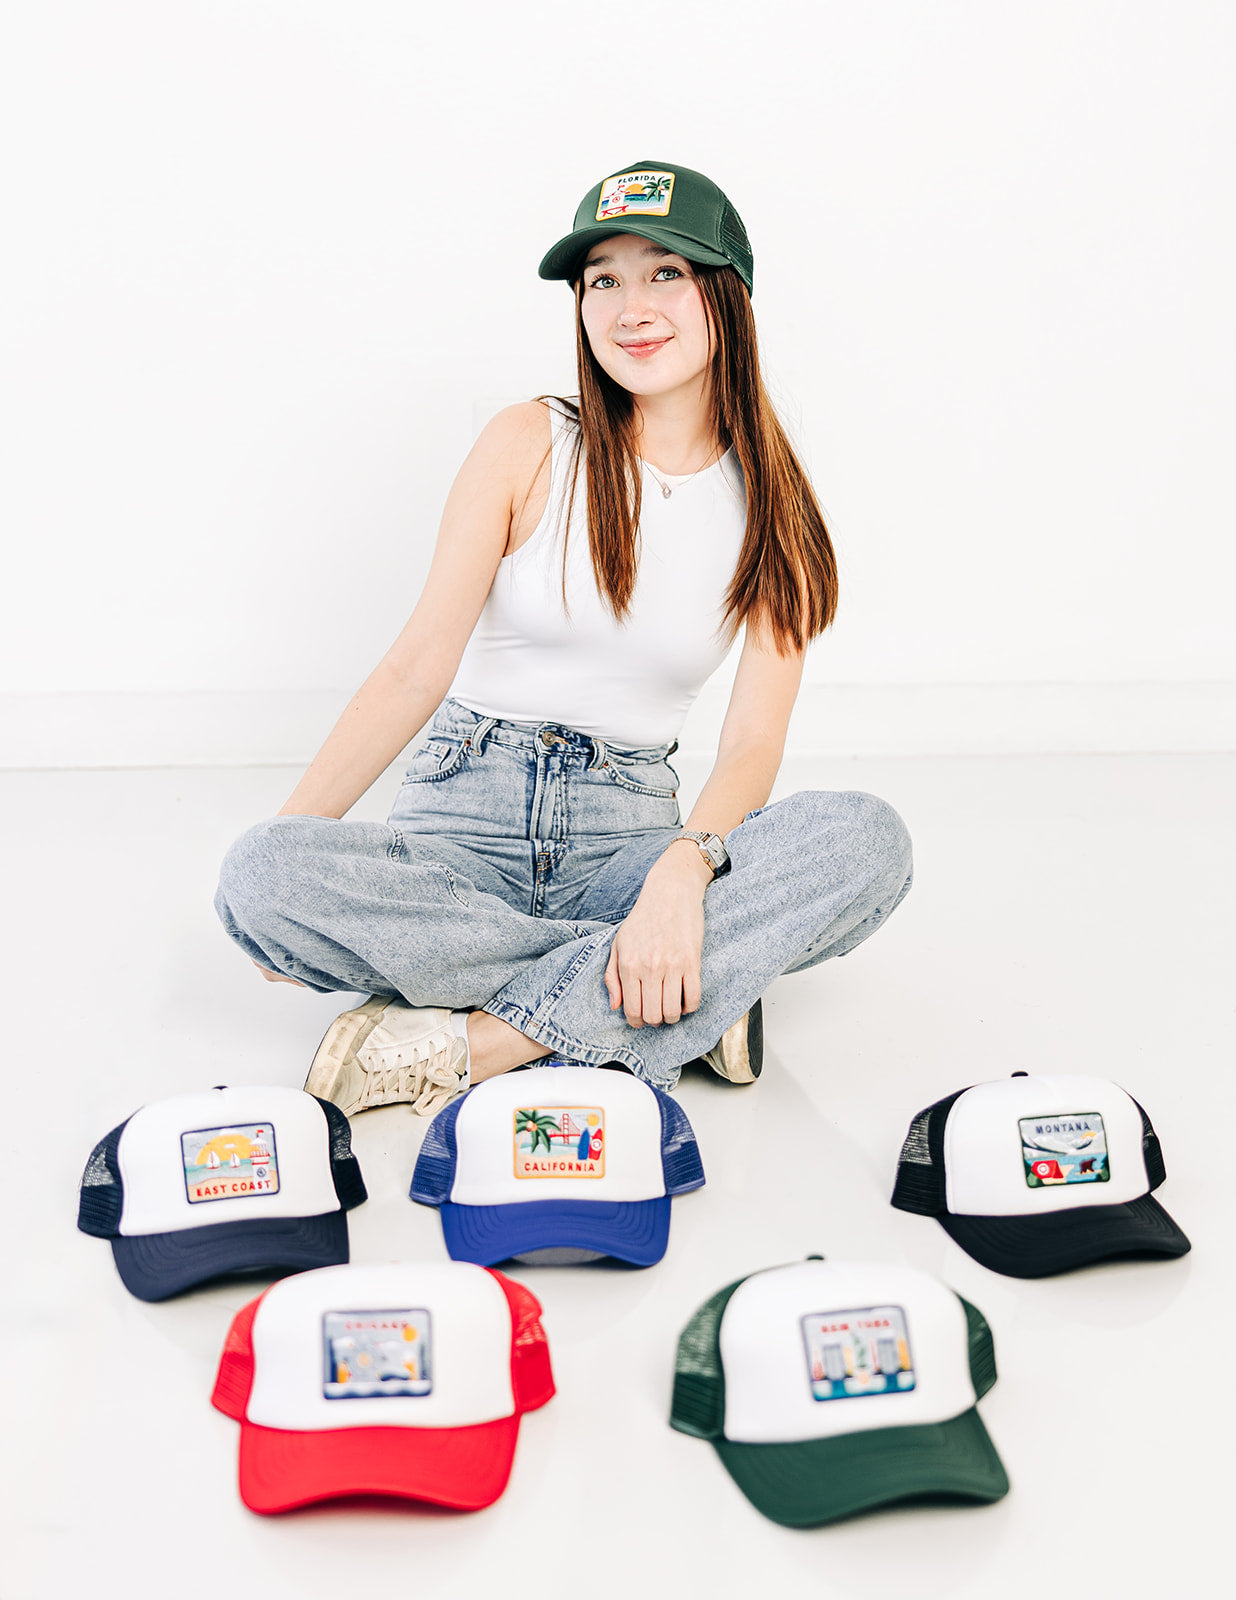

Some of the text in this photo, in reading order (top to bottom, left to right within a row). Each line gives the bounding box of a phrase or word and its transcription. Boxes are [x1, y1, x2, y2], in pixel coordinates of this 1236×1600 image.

[618, 175, 656, 184] FLORIDA
[1035, 1121, 1090, 1134] MONTANA
[524, 1162, 595, 1172] CALIFORNIA
[196, 1180, 271, 1197] EAST COAST
